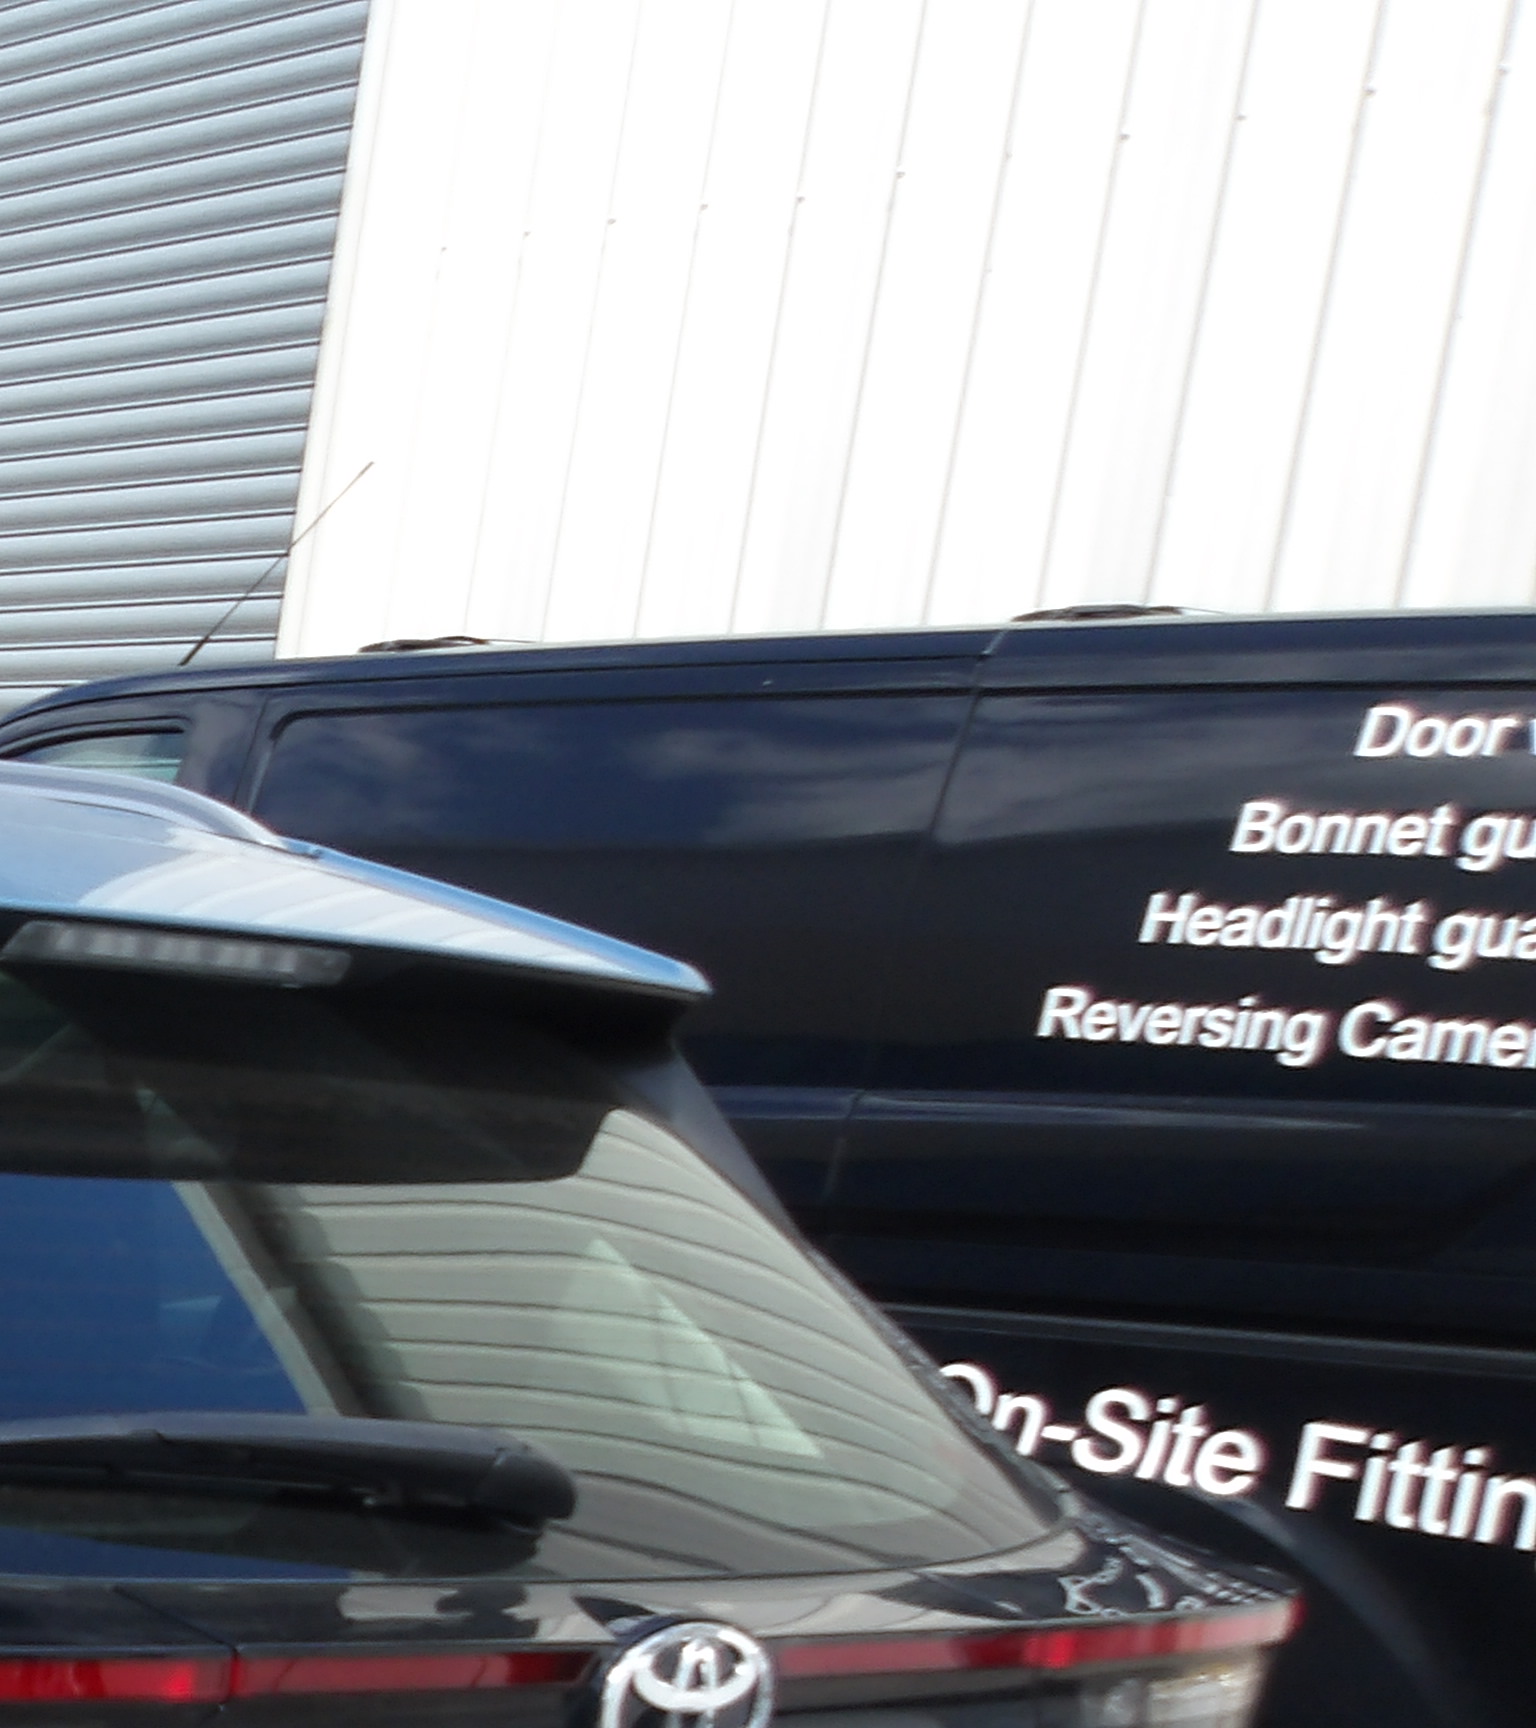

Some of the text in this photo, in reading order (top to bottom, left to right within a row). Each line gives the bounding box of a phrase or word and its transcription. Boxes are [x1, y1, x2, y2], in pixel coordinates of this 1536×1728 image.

[1353, 705, 1522, 758] Door
[1229, 800, 1455, 858] Bonnet
[1137, 891, 1428, 966] Headlight
[1035, 985, 1329, 1069] Reversing
